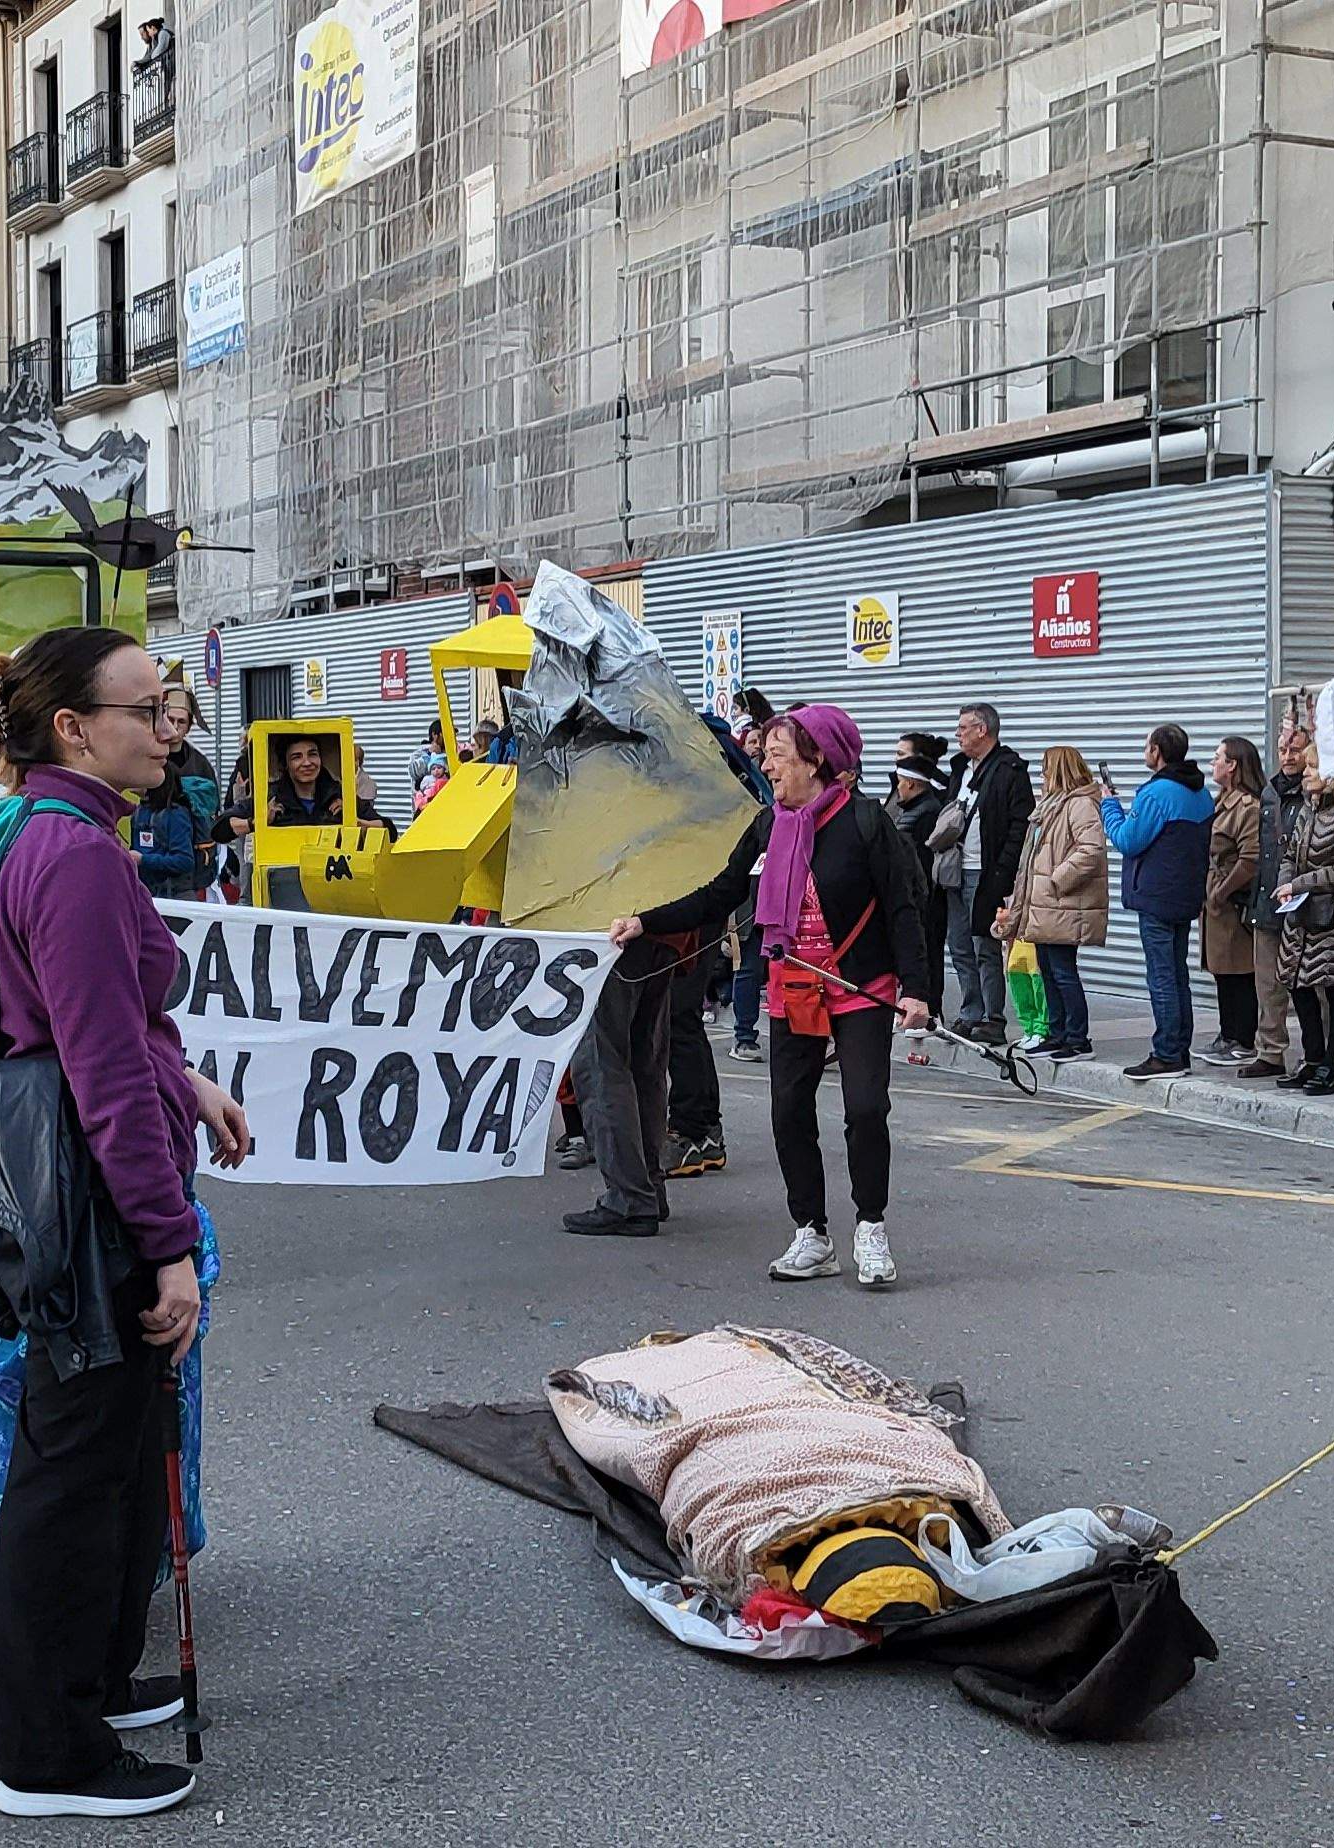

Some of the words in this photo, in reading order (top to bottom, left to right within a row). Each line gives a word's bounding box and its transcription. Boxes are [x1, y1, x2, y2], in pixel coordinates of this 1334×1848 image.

[1038, 616, 1092, 638] Añaños
[1050, 638, 1092, 649] Constructora
[295, 1047, 556, 1168] ROYA!
